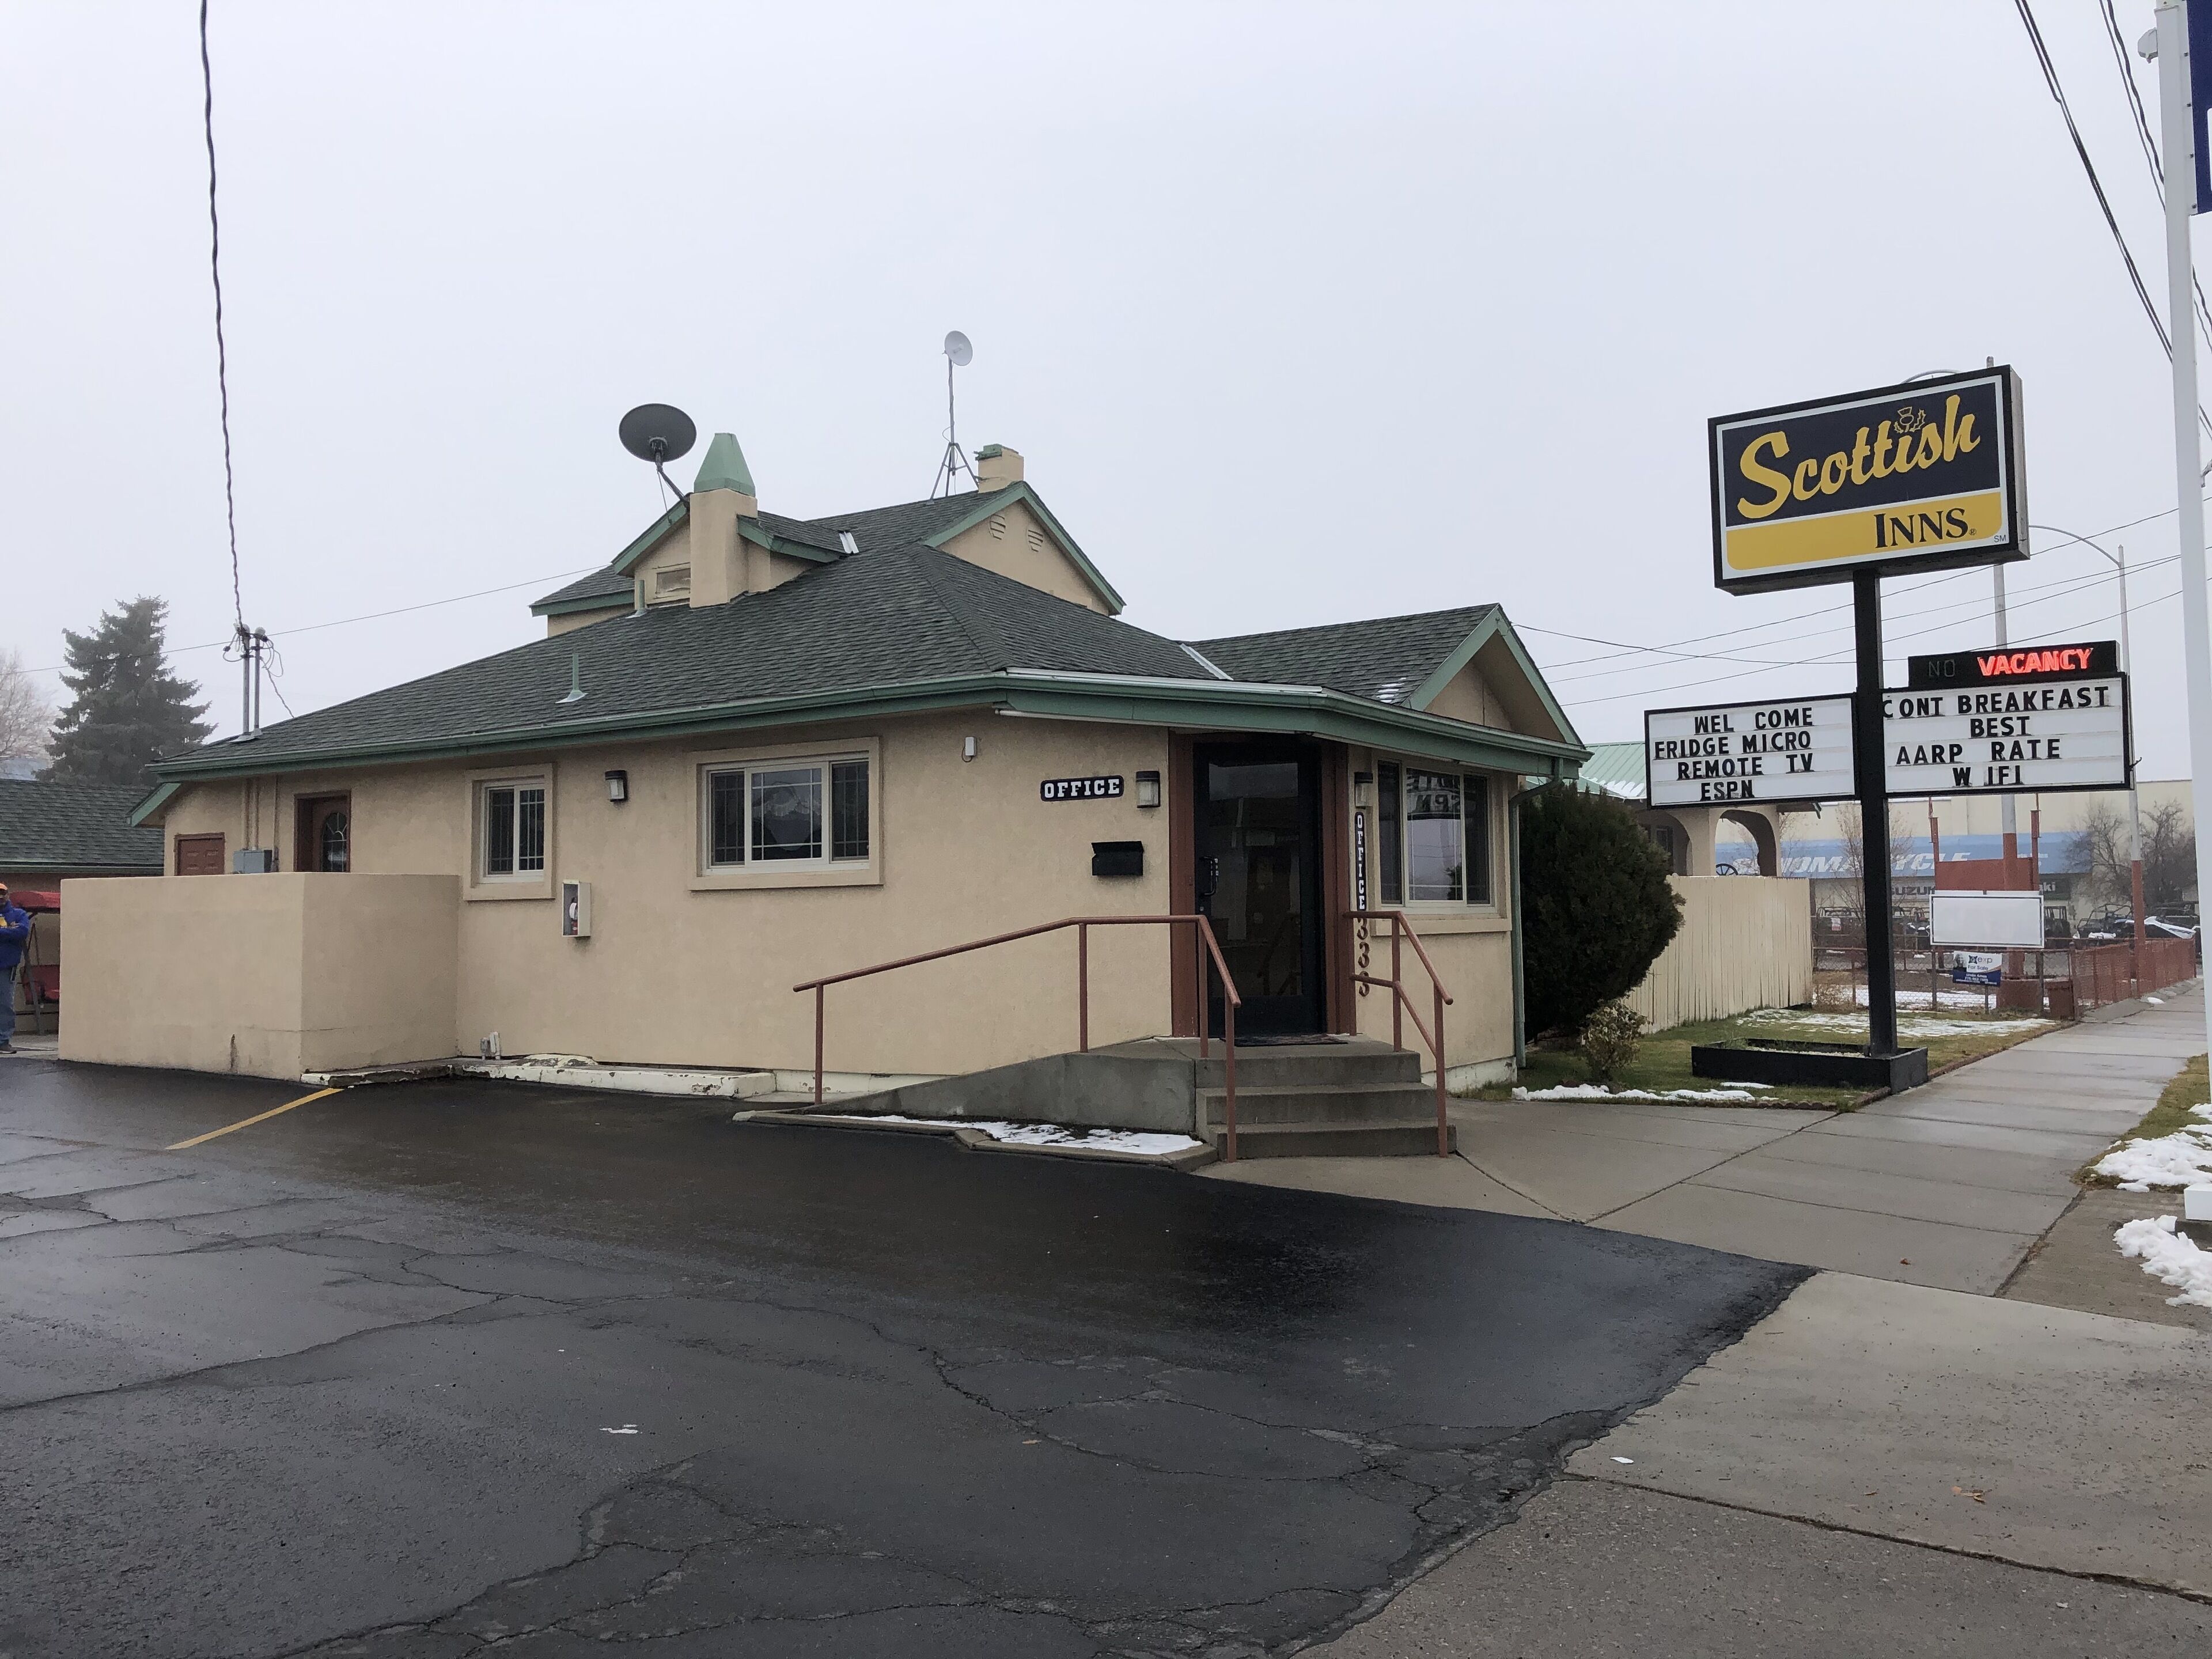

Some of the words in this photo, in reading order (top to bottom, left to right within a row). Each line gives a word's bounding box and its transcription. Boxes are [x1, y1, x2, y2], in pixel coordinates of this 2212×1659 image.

[1737, 395, 1980, 519] Scottish
[1874, 507, 1968, 548] INNS
[1994, 535, 2006, 543] SM
[1928, 658, 1956, 678] NO
[1976, 647, 2094, 676] VACANCY
[1883, 696, 1944, 718] CONT
[1959, 685, 2109, 714] BREAKFAST
[1970, 715, 2031, 737] BEST
[1654, 736, 1729, 759] FRIDGE
[1742, 730, 1811, 753] MICRO
[1896, 743, 1963, 765] AARP
[1991, 738, 2061, 760] RATE
[1677, 756, 1764, 779] REMOTE
[1786, 753, 1814, 772] TV
[1044, 779, 1120, 798] OFFICE
[1700, 779, 1755, 801] ESPN
[1357, 815, 1365, 910] OFFICE
[1357, 918, 1370, 997] 333
